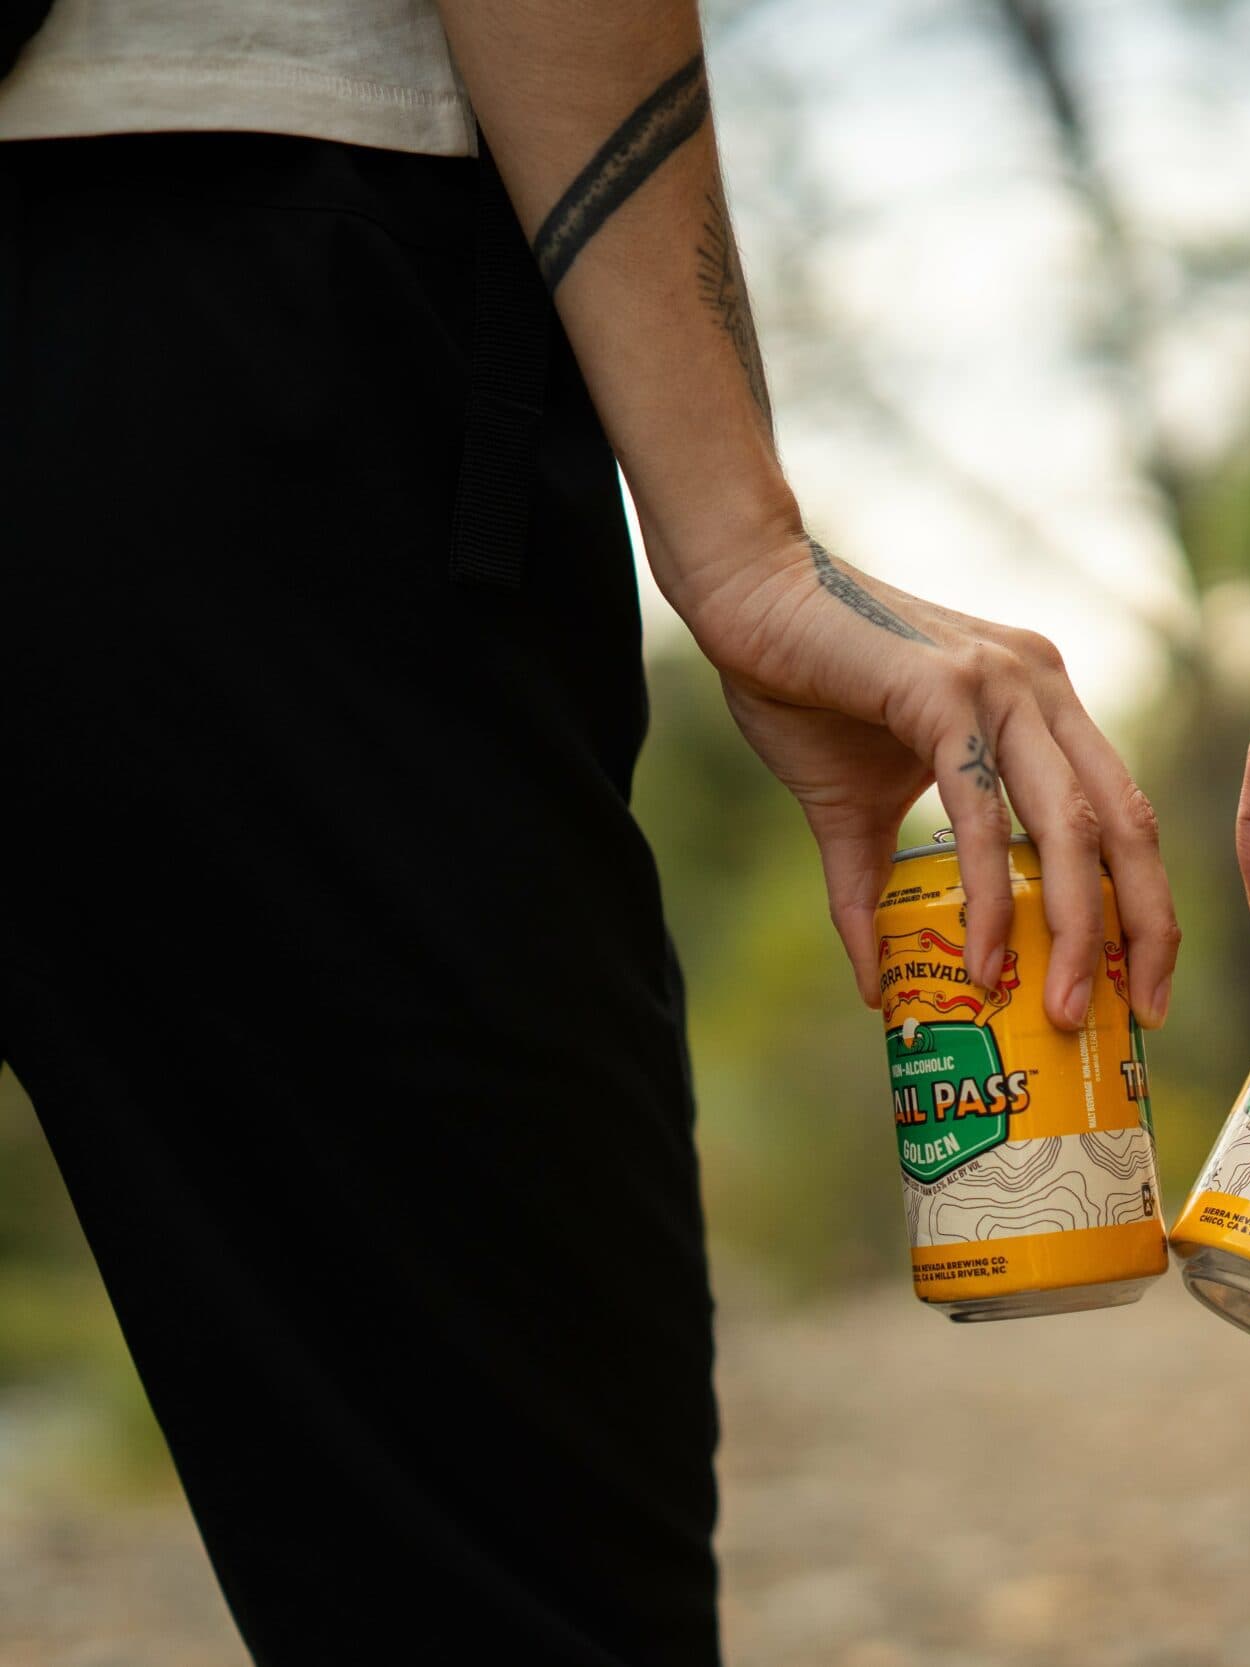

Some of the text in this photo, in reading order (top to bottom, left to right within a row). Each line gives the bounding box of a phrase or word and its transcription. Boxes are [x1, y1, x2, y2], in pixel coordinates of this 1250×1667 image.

[921, 890, 941, 900] OVER
[894, 1086, 927, 1125] AIL
[932, 1071, 1030, 1121] PASS
[903, 1132, 960, 1164] GOLDEN
[933, 1182, 947, 1195] 0.5%
[946, 1174, 959, 1185] ALC
[959, 1167, 968, 1178] BY
[968, 1160, 983, 1172] VOL
[1203, 1206, 1231, 1219] SIERRA
[1199, 1215, 1225, 1228] CHICO,
[1227, 1221, 1239, 1231] CA
[1241, 1226, 1247, 1234] &
[946, 1257, 989, 1270] BREWING
[991, 1256, 1008, 1265] CO.
[934, 1271, 956, 1280] MILLS
[957, 1268, 990, 1278] RIVER,
[992, 1266, 1007, 1275] NC
